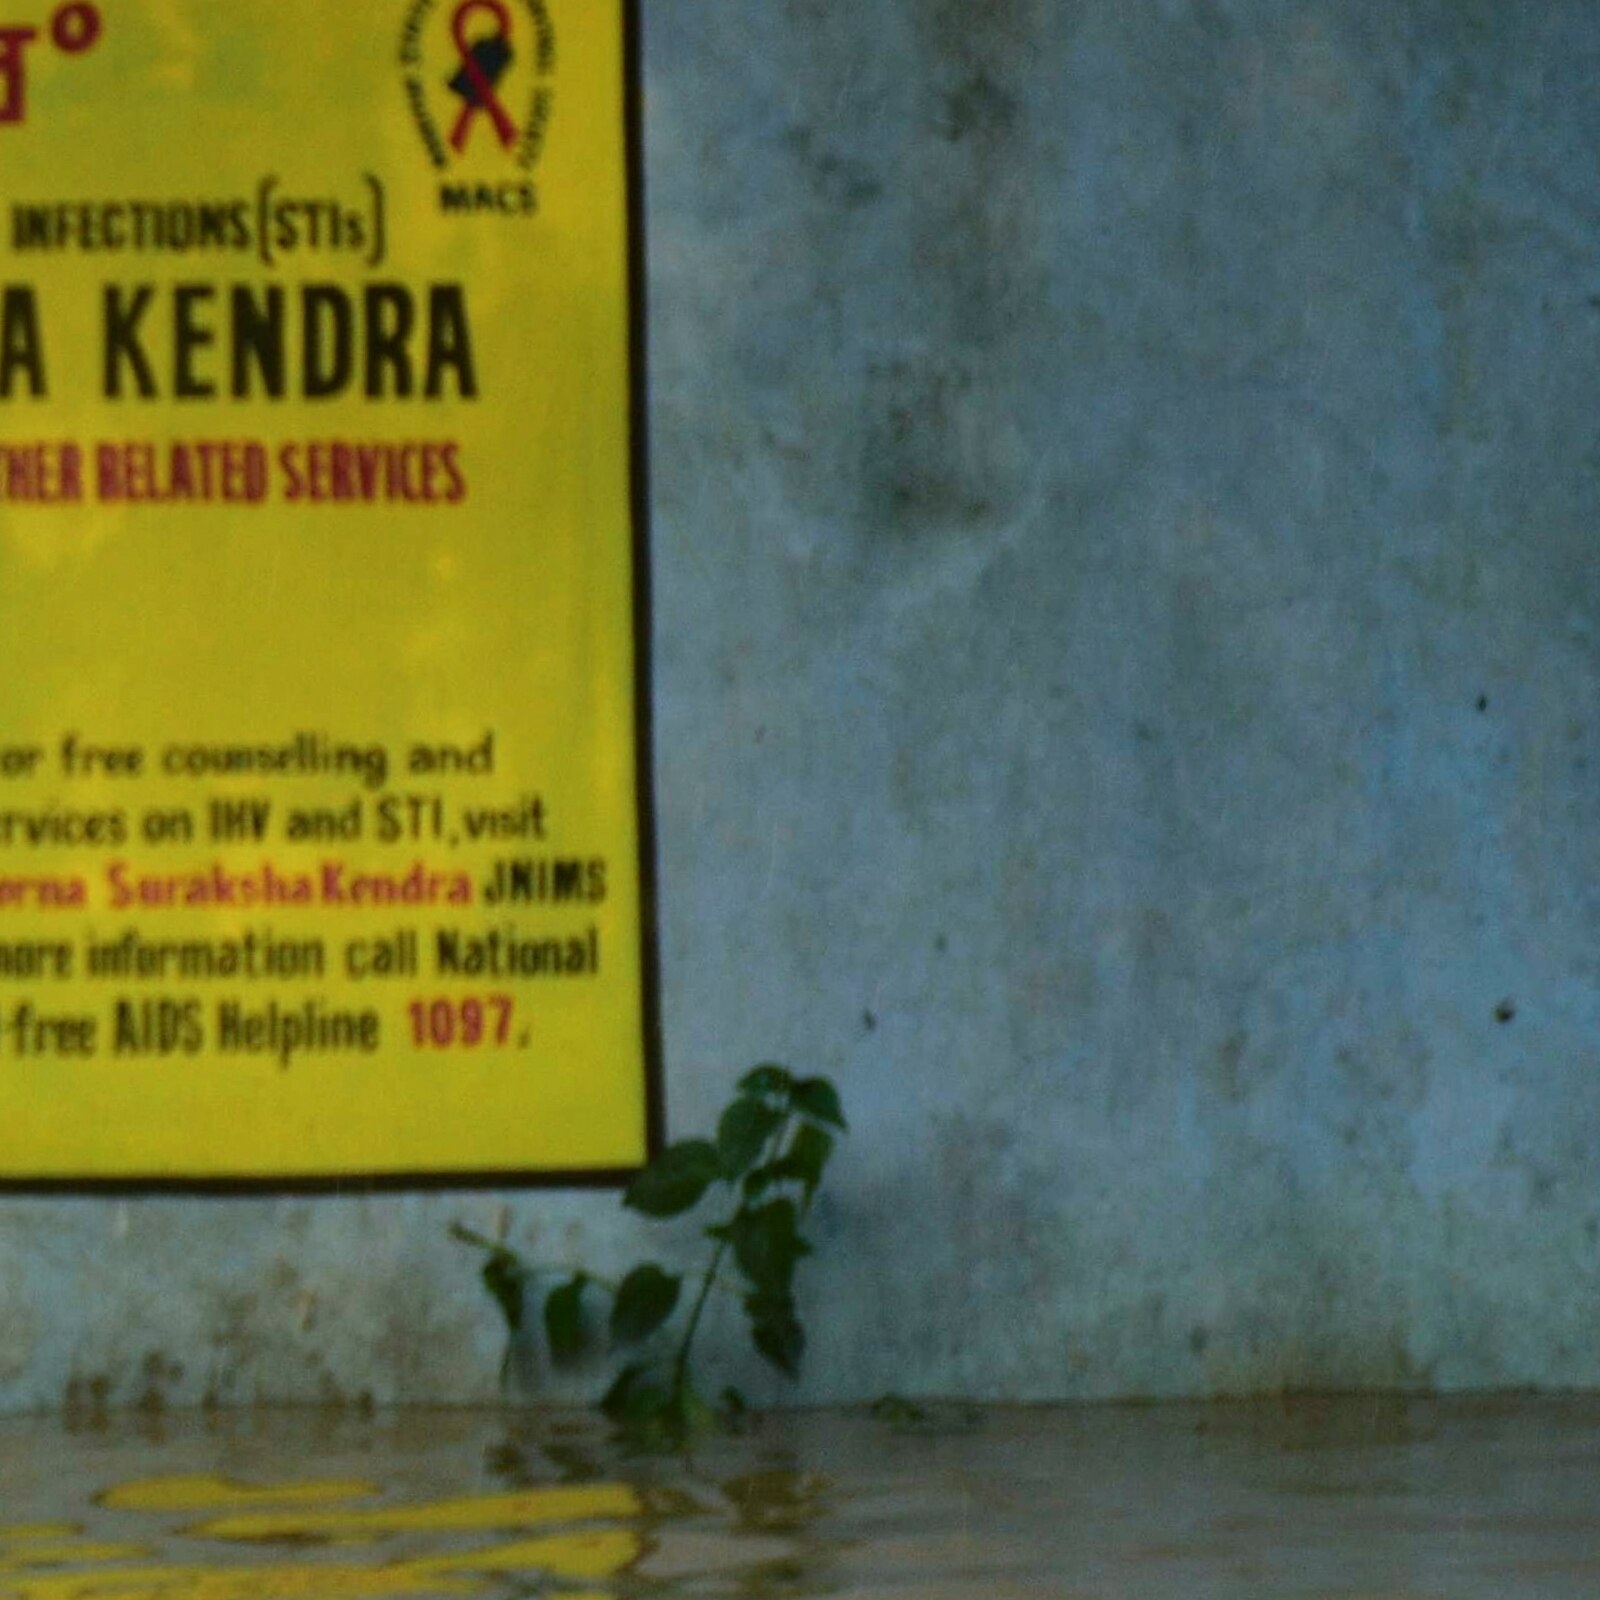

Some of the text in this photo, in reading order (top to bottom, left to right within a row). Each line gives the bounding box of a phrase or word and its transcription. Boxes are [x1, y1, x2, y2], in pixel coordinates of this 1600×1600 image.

[102, 281, 478, 401] KENDRA
[95, 440, 269, 505] RELATED
[277, 440, 466, 505] SERVICES
[60, 734, 144, 777] free
[161, 732, 388, 790] counselling
[407, 731, 494, 776] and
[140, 808, 195, 845] on
[285, 799, 363, 841] and
[484, 858, 606, 903] JNIMS
[85, 929, 326, 981] information
[343, 929, 418, 981] call
[435, 927, 599, 979] National
[112, 997, 203, 1055] AIDS
[216, 1000, 381, 1069] Helpline
